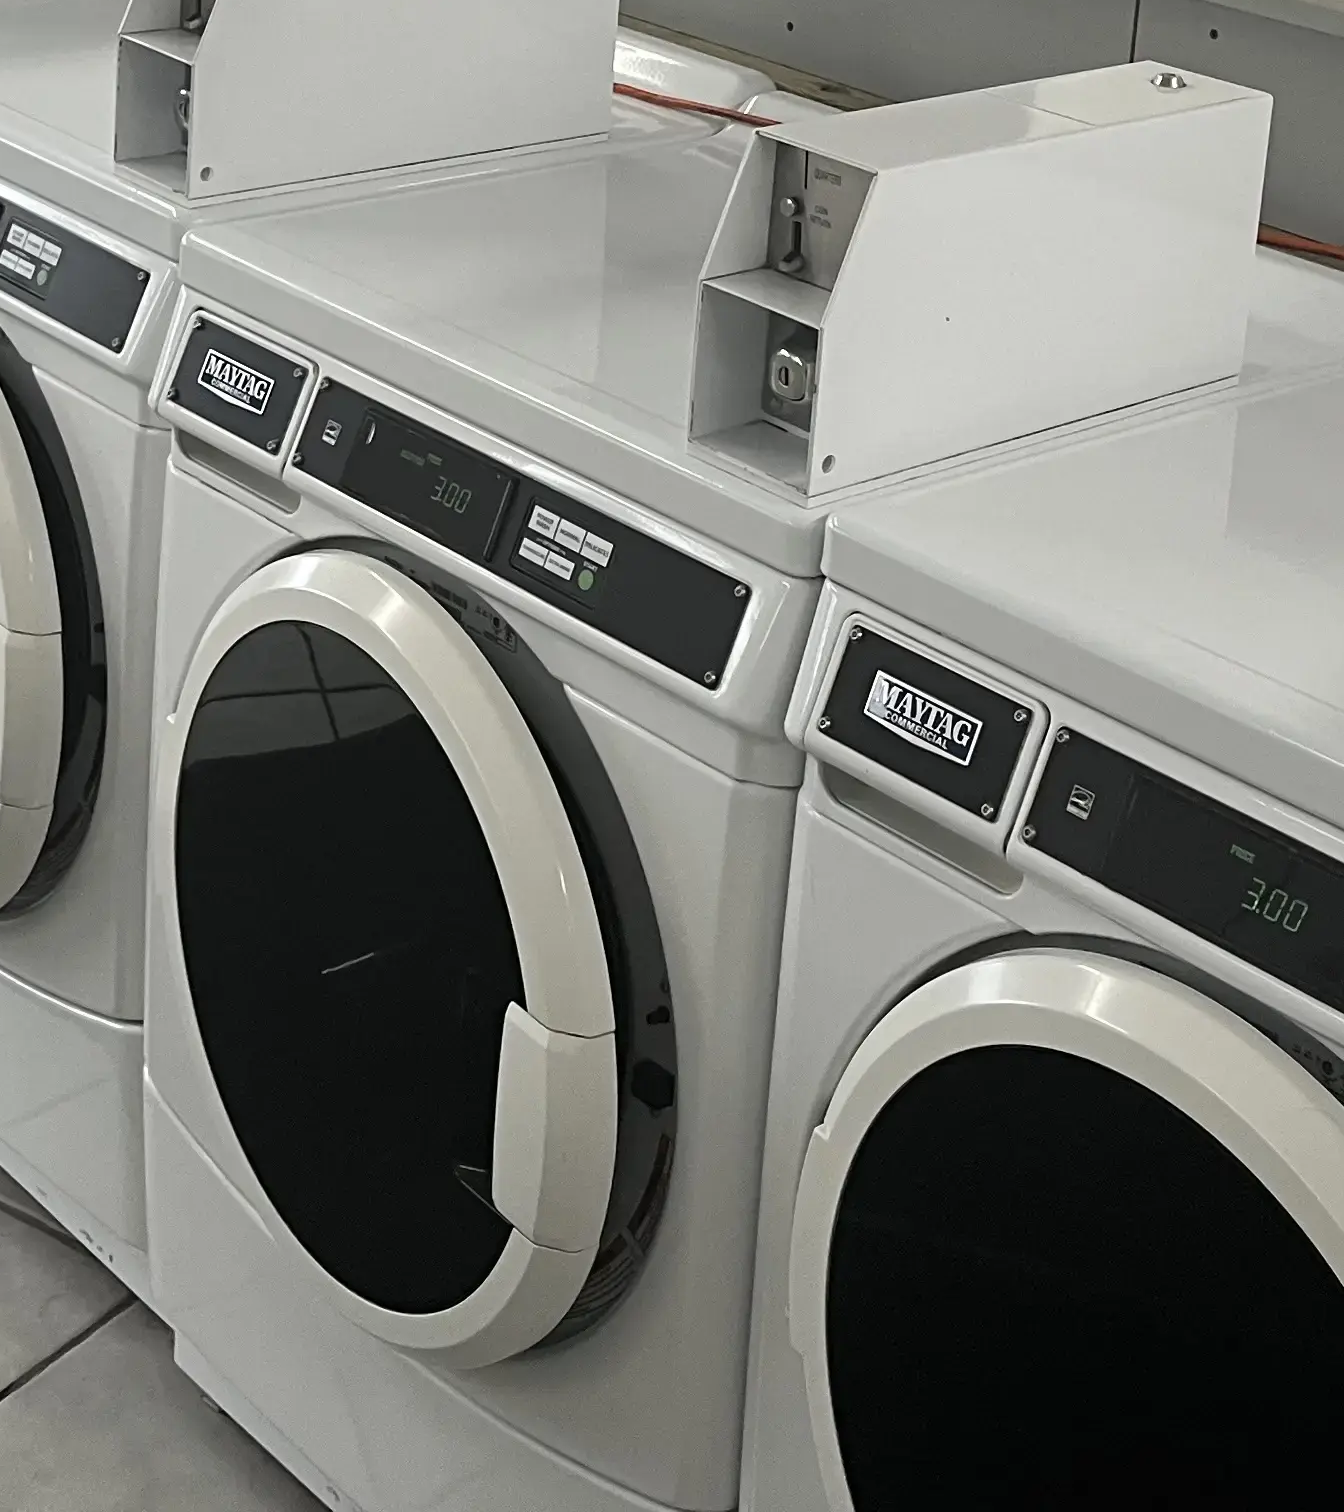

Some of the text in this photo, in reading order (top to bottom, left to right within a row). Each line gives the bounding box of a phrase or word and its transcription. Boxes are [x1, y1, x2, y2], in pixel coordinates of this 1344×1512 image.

[205, 354, 268, 400] MAYTAG
[876, 678, 973, 747] MAYTAG
[885, 710, 948, 750] COMMERCIAL
[1241, 876, 1309, 933] 3.00
